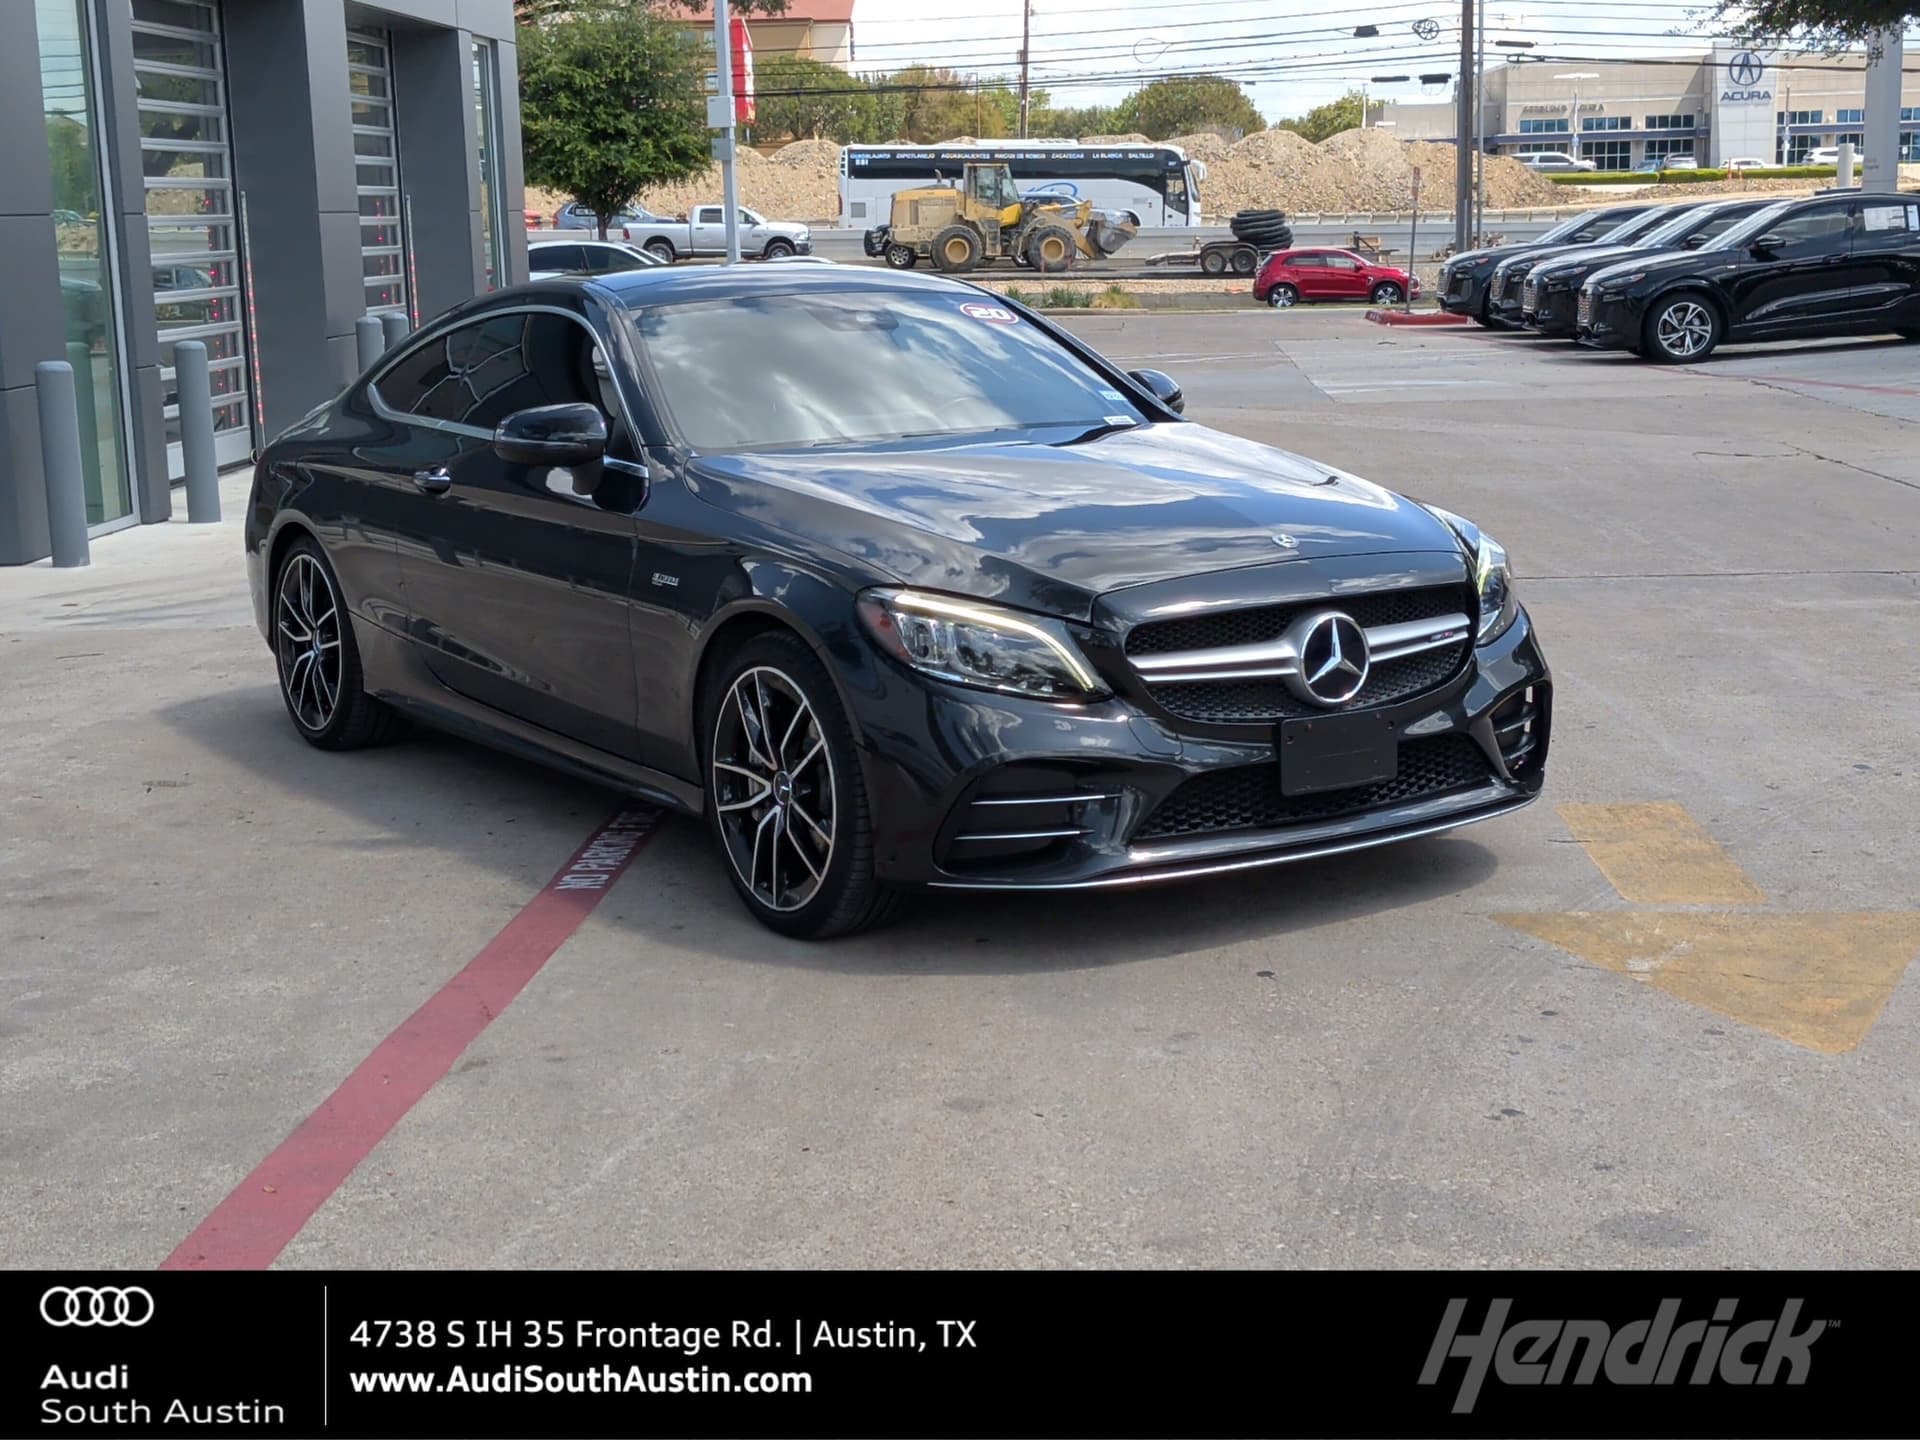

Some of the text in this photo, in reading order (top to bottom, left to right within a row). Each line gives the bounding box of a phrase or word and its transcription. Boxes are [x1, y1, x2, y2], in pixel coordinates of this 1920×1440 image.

[1720, 90, 1772, 101] ACURA
[966, 306, 1012, 320] 20
[553, 873, 611, 890] NO
